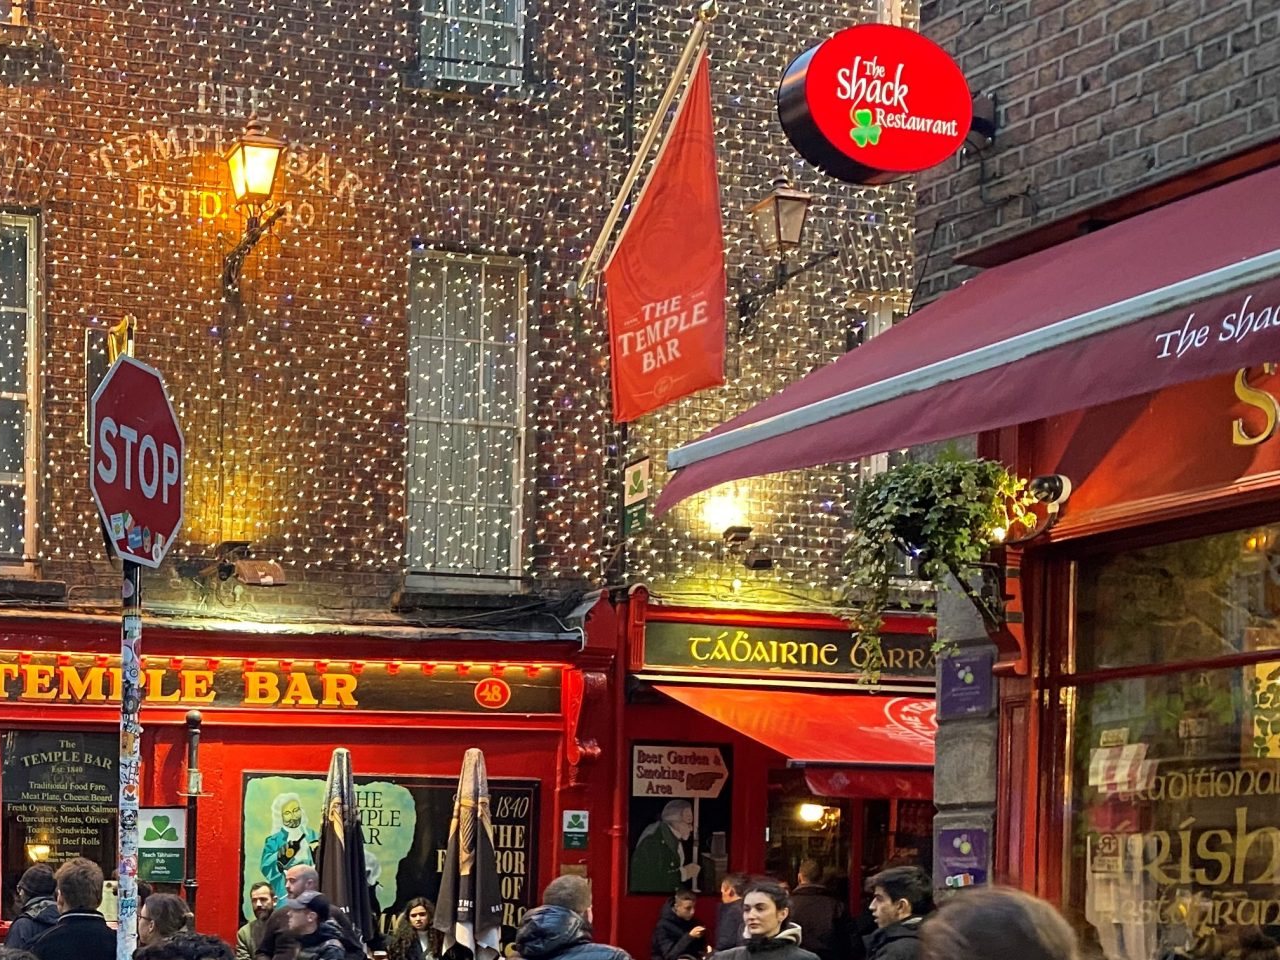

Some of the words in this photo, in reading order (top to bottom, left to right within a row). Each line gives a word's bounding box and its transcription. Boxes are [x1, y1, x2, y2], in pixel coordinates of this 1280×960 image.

[863, 56, 885, 79] The
[837, 56, 909, 114] Shack
[190, 80, 271, 121] THE
[875, 108, 958, 136] Restaurant
[89, 124, 227, 176] TEMPL
[641, 296, 682, 322] THE
[618, 301, 708, 357] TEMPLE
[1155, 313, 1210, 358] The
[1219, 295, 1280, 343] Shac
[642, 338, 681, 374] BAR
[97, 416, 179, 504] STOP
[244, 671, 359, 708] BAR
[480, 684, 502, 702] 48
[59, 740, 76, 749] The
[20, 752, 80, 767] TEMPLE
[83, 753, 113, 770] BAR
[637, 750, 663, 764] Beer
[667, 751, 709, 765] Garden
[636, 766, 685, 782] Smoking
[29, 782, 68, 790] Traditional
[90, 783, 106, 791] Fare
[646, 781, 673, 794] Area
[21, 792, 40, 800] Meat
[64, 793, 90, 801] Cheese
[91, 794, 113, 802] Board
[357, 791, 382, 808] HE
[7, 803, 28, 812] Fresh
[29, 804, 58, 813] Oysters,
[60, 804, 89, 812] Smoked
[91, 804, 118, 813] Salmon
[496, 796, 528, 818] 1840
[60, 815, 84, 824] Meats,
[85, 815, 109, 824] Olives
[56, 826, 98, 835] Sandwiches
[363, 828, 383, 846] AR
[62, 837, 80, 845] Beef
[81, 837, 100, 845] Rolls
[502, 876, 524, 900] OF
